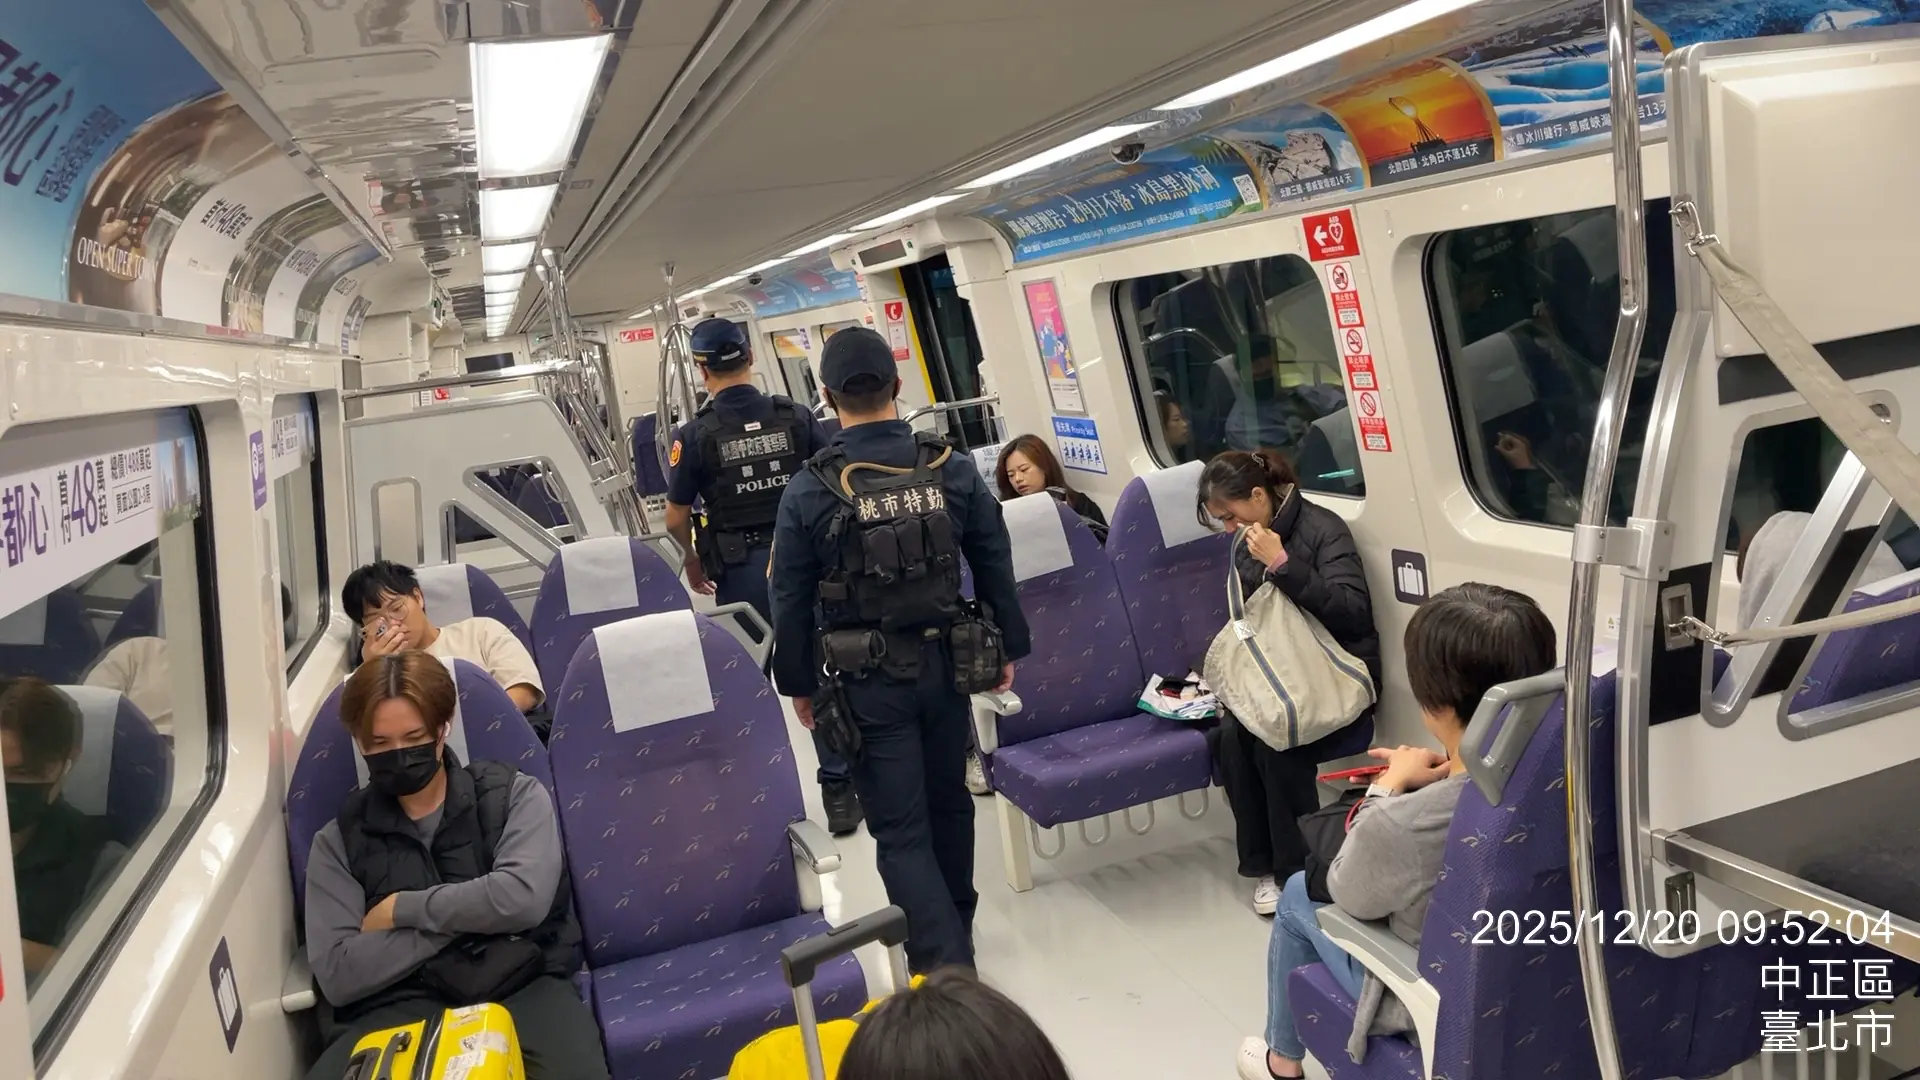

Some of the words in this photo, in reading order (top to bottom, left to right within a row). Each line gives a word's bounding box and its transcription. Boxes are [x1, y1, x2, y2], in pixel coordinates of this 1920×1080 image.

[77, 237, 106, 269] OPEN
[106, 244, 133, 277] SUPER
[735, 474, 791, 494] POLICE
[858, 486, 944, 520] 桃市特勤
[0, 482, 49, 568] 都心
